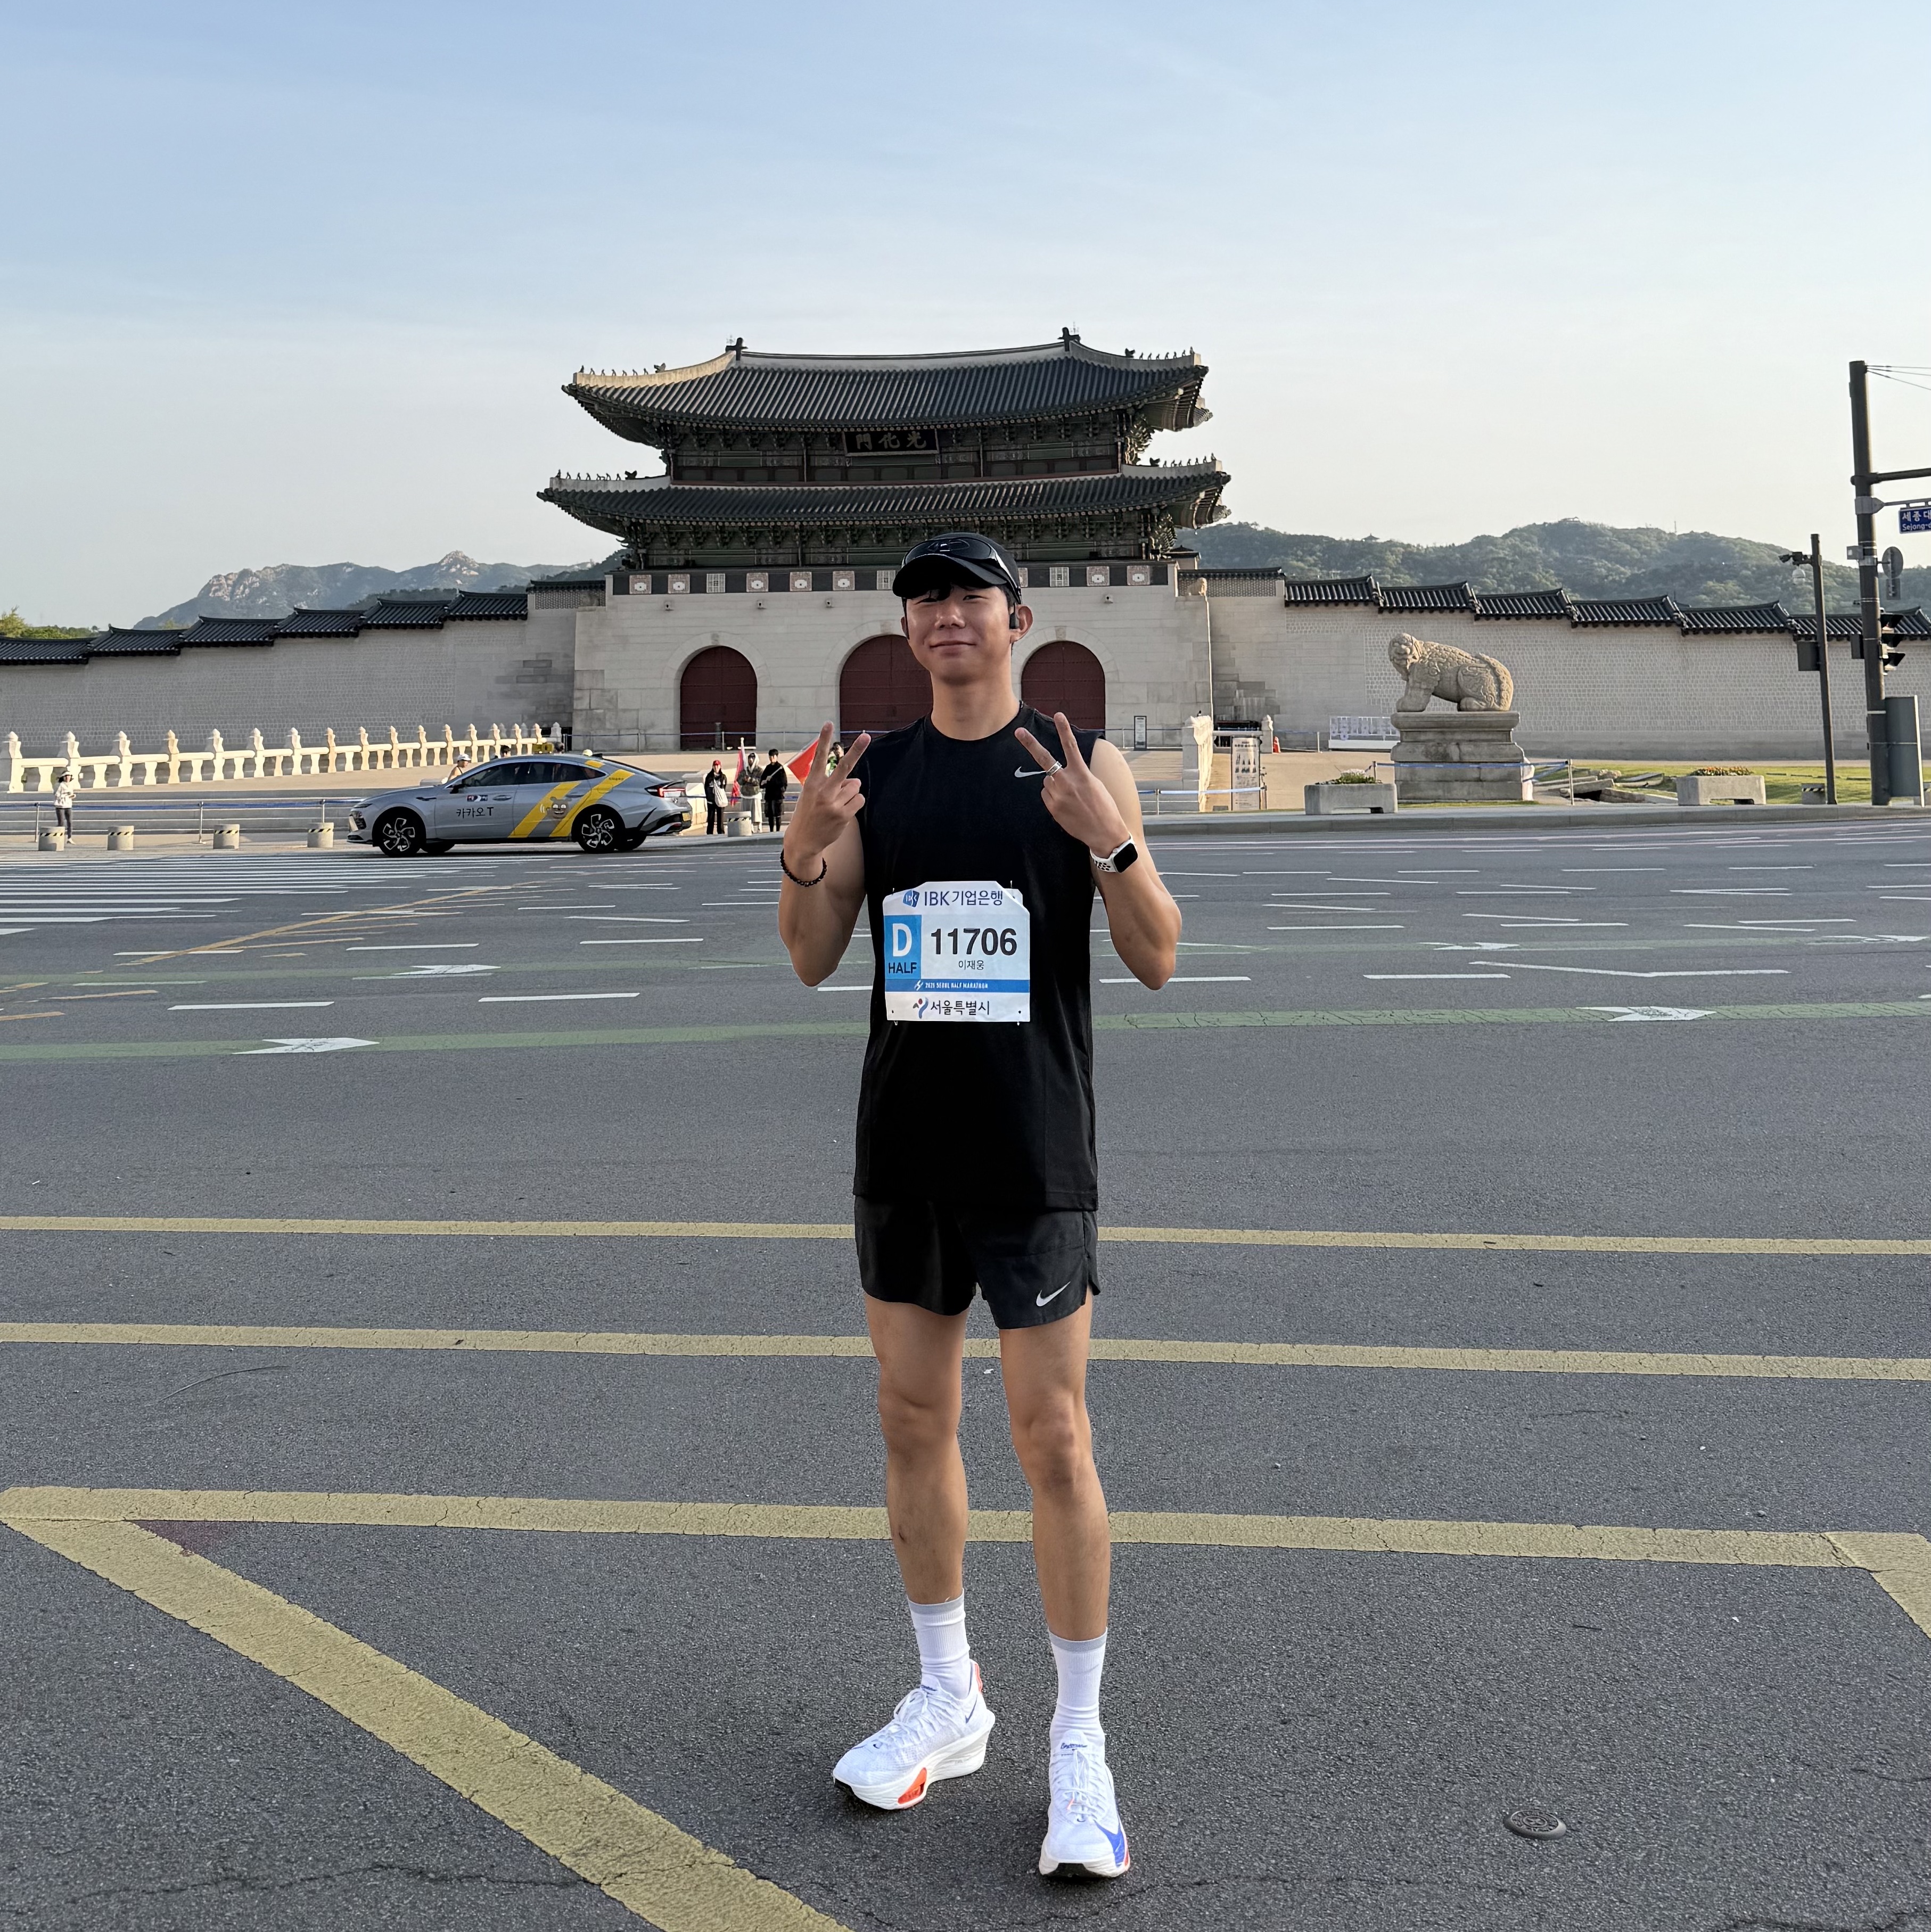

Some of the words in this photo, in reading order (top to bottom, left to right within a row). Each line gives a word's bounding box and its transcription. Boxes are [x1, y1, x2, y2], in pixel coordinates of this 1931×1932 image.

[456, 807, 485, 818] 카카오
[487, 807, 494, 816] T
[892, 923, 912, 957] D
[931, 928, 1017, 956] 11706
[888, 962, 917, 974] HALF
[958, 960, 984, 970] 이재웅
[931, 1000, 990, 1015] 서울특별시
